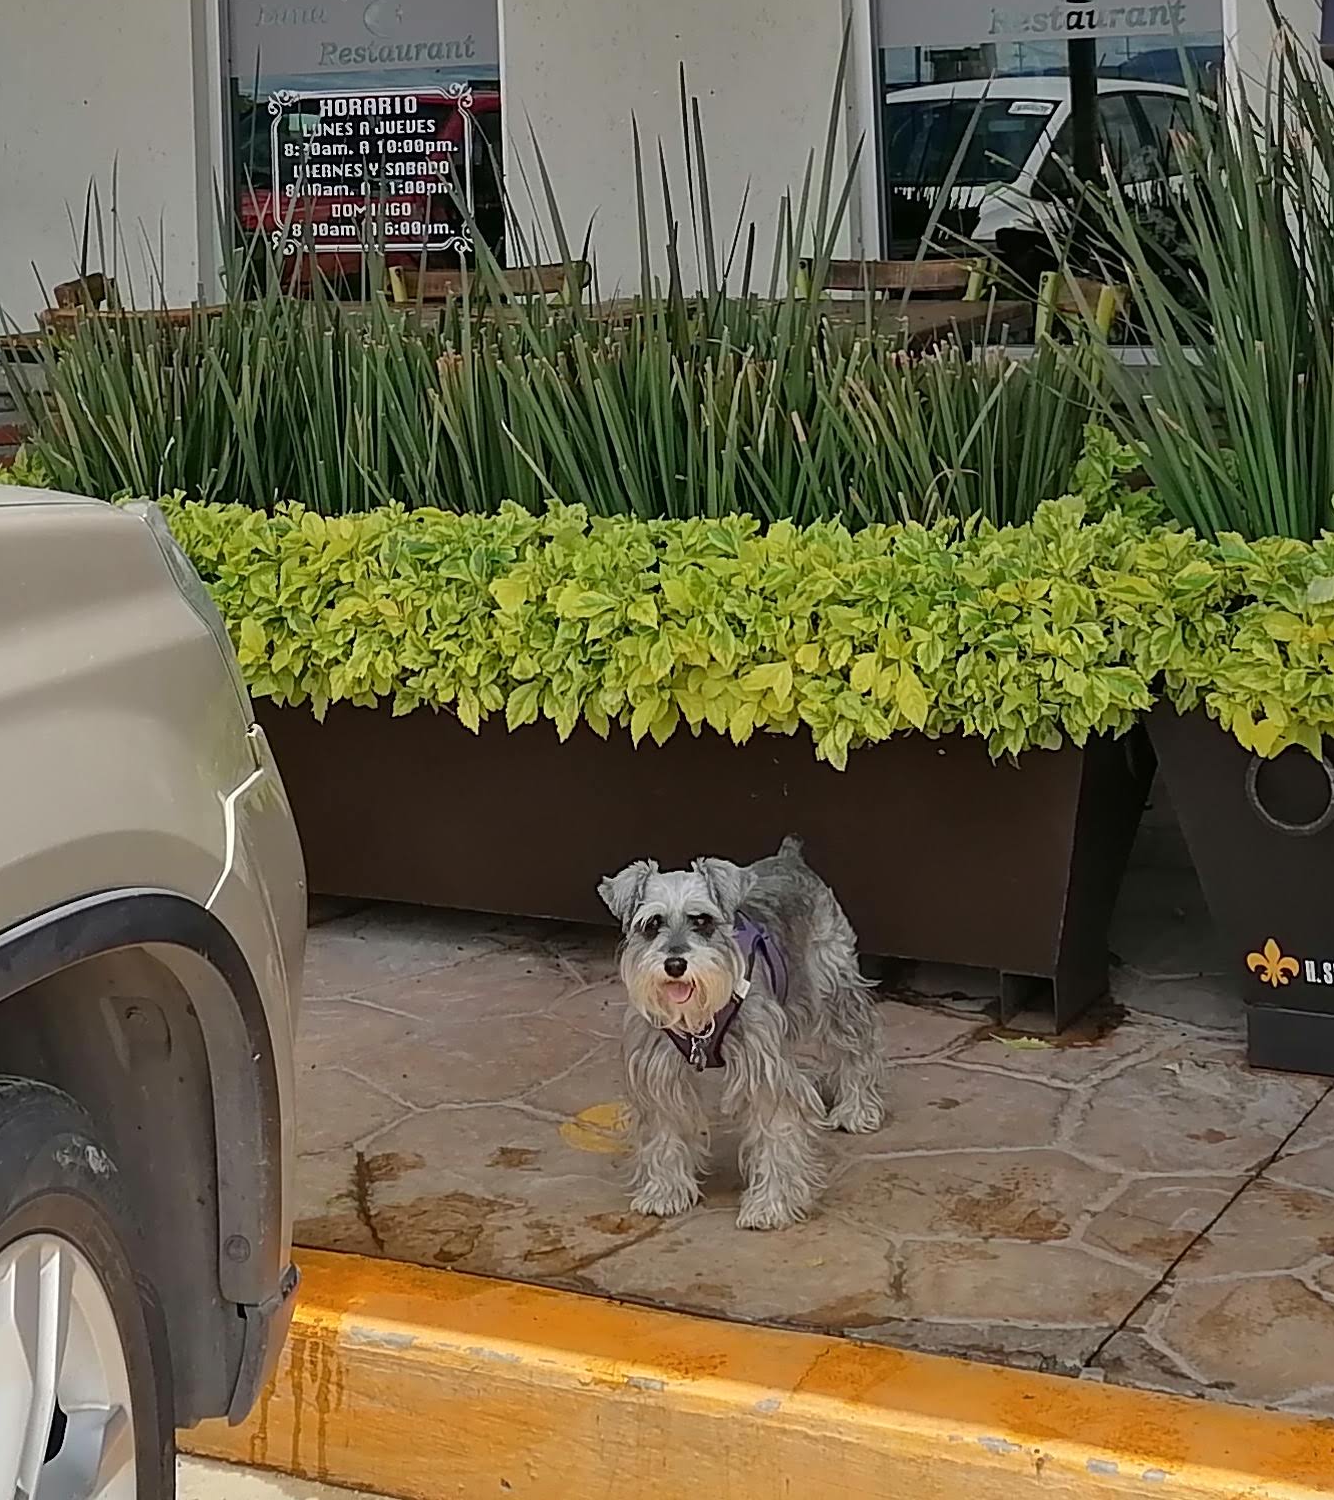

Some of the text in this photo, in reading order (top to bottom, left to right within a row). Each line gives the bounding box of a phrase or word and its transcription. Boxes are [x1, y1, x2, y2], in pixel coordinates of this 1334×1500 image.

[255, 4, 329, 27] Luna
[318, 33, 476, 66] Restaurant
[319, 96, 418, 117] HORARIO
[303, 119, 436, 138] LUNES A JUEVES
[359, 140, 370, 155] A
[377, 139, 459, 156] 10:00pm.
[368, 162, 379, 176] Y
[378, 180, 458, 196] 1:00pm.
